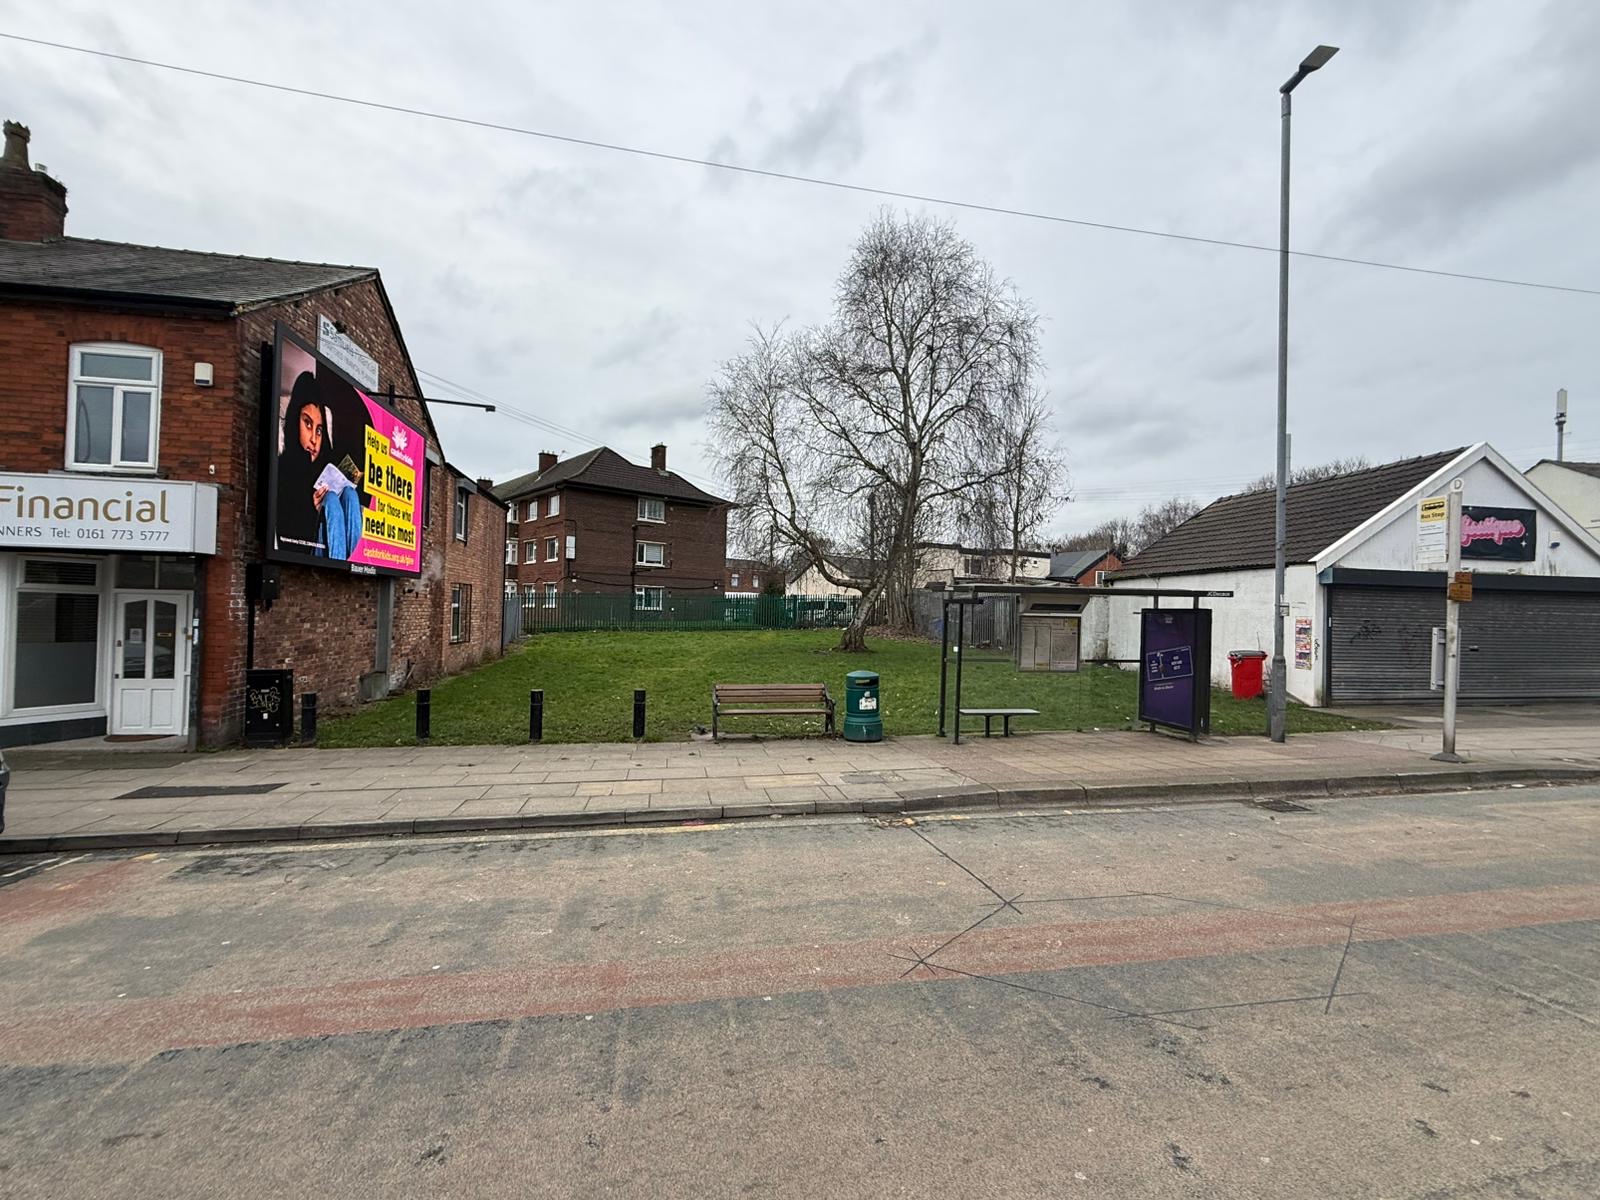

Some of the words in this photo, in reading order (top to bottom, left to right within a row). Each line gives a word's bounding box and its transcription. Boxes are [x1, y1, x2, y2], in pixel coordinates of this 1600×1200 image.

[367, 430, 379, 453] Help
[381, 441, 388, 455] us
[368, 453, 383, 488] be
[386, 465, 412, 501] there
[1454, 479, 1462, 490] D
[377, 498, 386, 513] for
[386, 502, 401, 519] those
[402, 509, 411, 523] who
[1431, 511, 1445, 519] Stop
[51, 527, 70, 538] Tel:
[77, 528, 105, 539] 0161
[112, 529, 133, 540] 773
[140, 530, 170, 542] 5777
[365, 516, 386, 537] need
[387, 523, 396, 540] us
[398, 527, 415, 545] most
